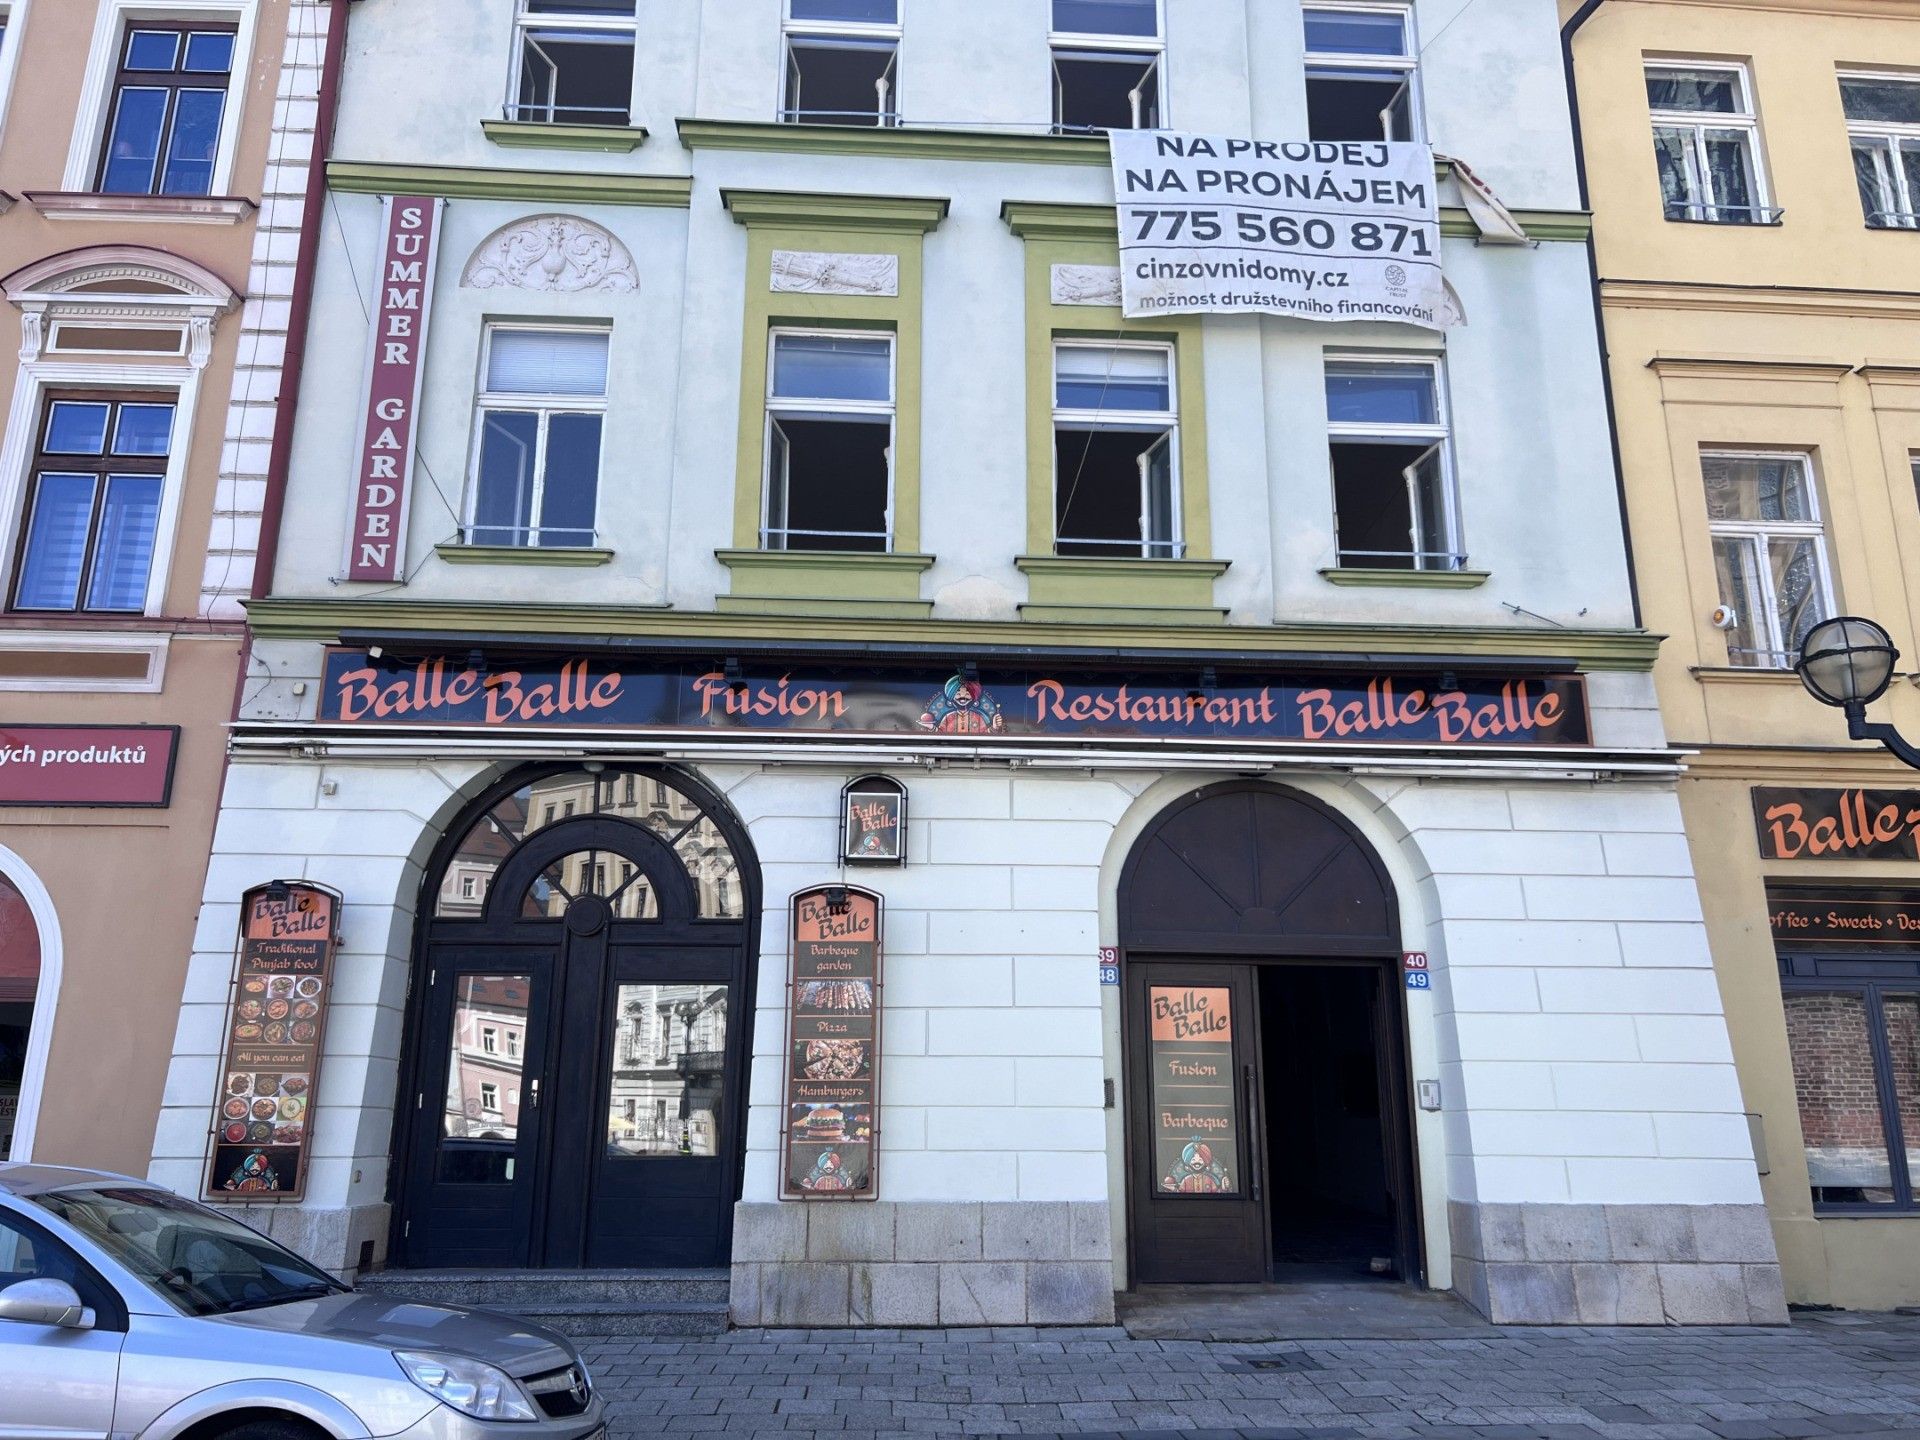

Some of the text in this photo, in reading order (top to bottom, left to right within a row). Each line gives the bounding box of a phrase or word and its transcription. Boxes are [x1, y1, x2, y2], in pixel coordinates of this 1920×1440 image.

[1156, 136, 1389, 168] NA PRODEJ
[1125, 168, 1426, 209] NA PRONÁJEM
[1131, 210, 1432, 257] 775 560 871
[1136, 257, 1350, 291] cinzovnidomy.cz
[382, 207, 424, 365] SUMMER
[1139, 292, 1217, 308] možnost
[1337, 299, 1433, 322] financování
[358, 398, 406, 568] GARDEN
[337, 655, 1565, 742] Balle Balle Fusion Restaurant Balle Balle
[40, 745, 147, 767] produktů
[851, 801, 886, 820] Balle
[861, 813, 897, 832] Balle
[1765, 788, 1905, 859] Balle
[271, 909, 327, 937] Balle
[818, 911, 870, 940] Balle
[1826, 911, 1883, 929] Sweets
[256, 942, 316, 955] Traditional
[810, 944, 859, 957] Barbeque
[251, 957, 317, 974] Punjab food
[816, 960, 852, 973] garden
[1406, 954, 1425, 967] 40
[1407, 974, 1427, 987] 49
[1153, 990, 1209, 1020] Balle
[816, 1021, 848, 1032] Pizza
[1173, 1008, 1228, 1039] Balle
[237, 1052, 305, 1065] All you can eat
[1168, 1060, 1217, 1077] Fusion
[797, 1084, 864, 1099] Hamburgers
[1161, 1112, 1229, 1132] Barbeque
